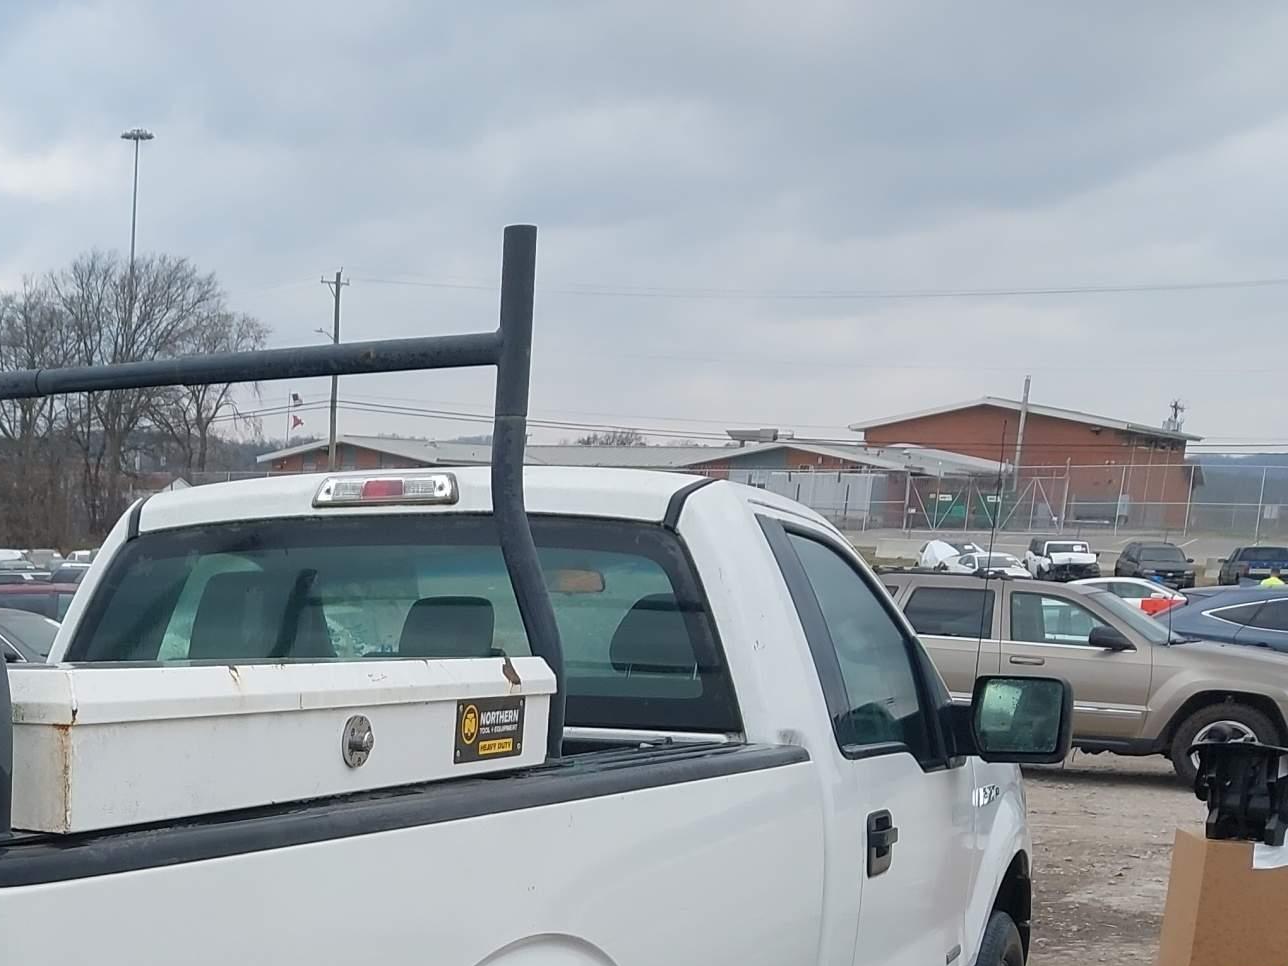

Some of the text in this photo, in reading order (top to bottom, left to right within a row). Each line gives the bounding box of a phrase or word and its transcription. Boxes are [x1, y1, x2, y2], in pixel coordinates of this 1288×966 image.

[480, 709, 519, 726] NORTHERN
[480, 727, 491, 735] TOOL
[480, 740, 512, 752] HEAVY DUTY
